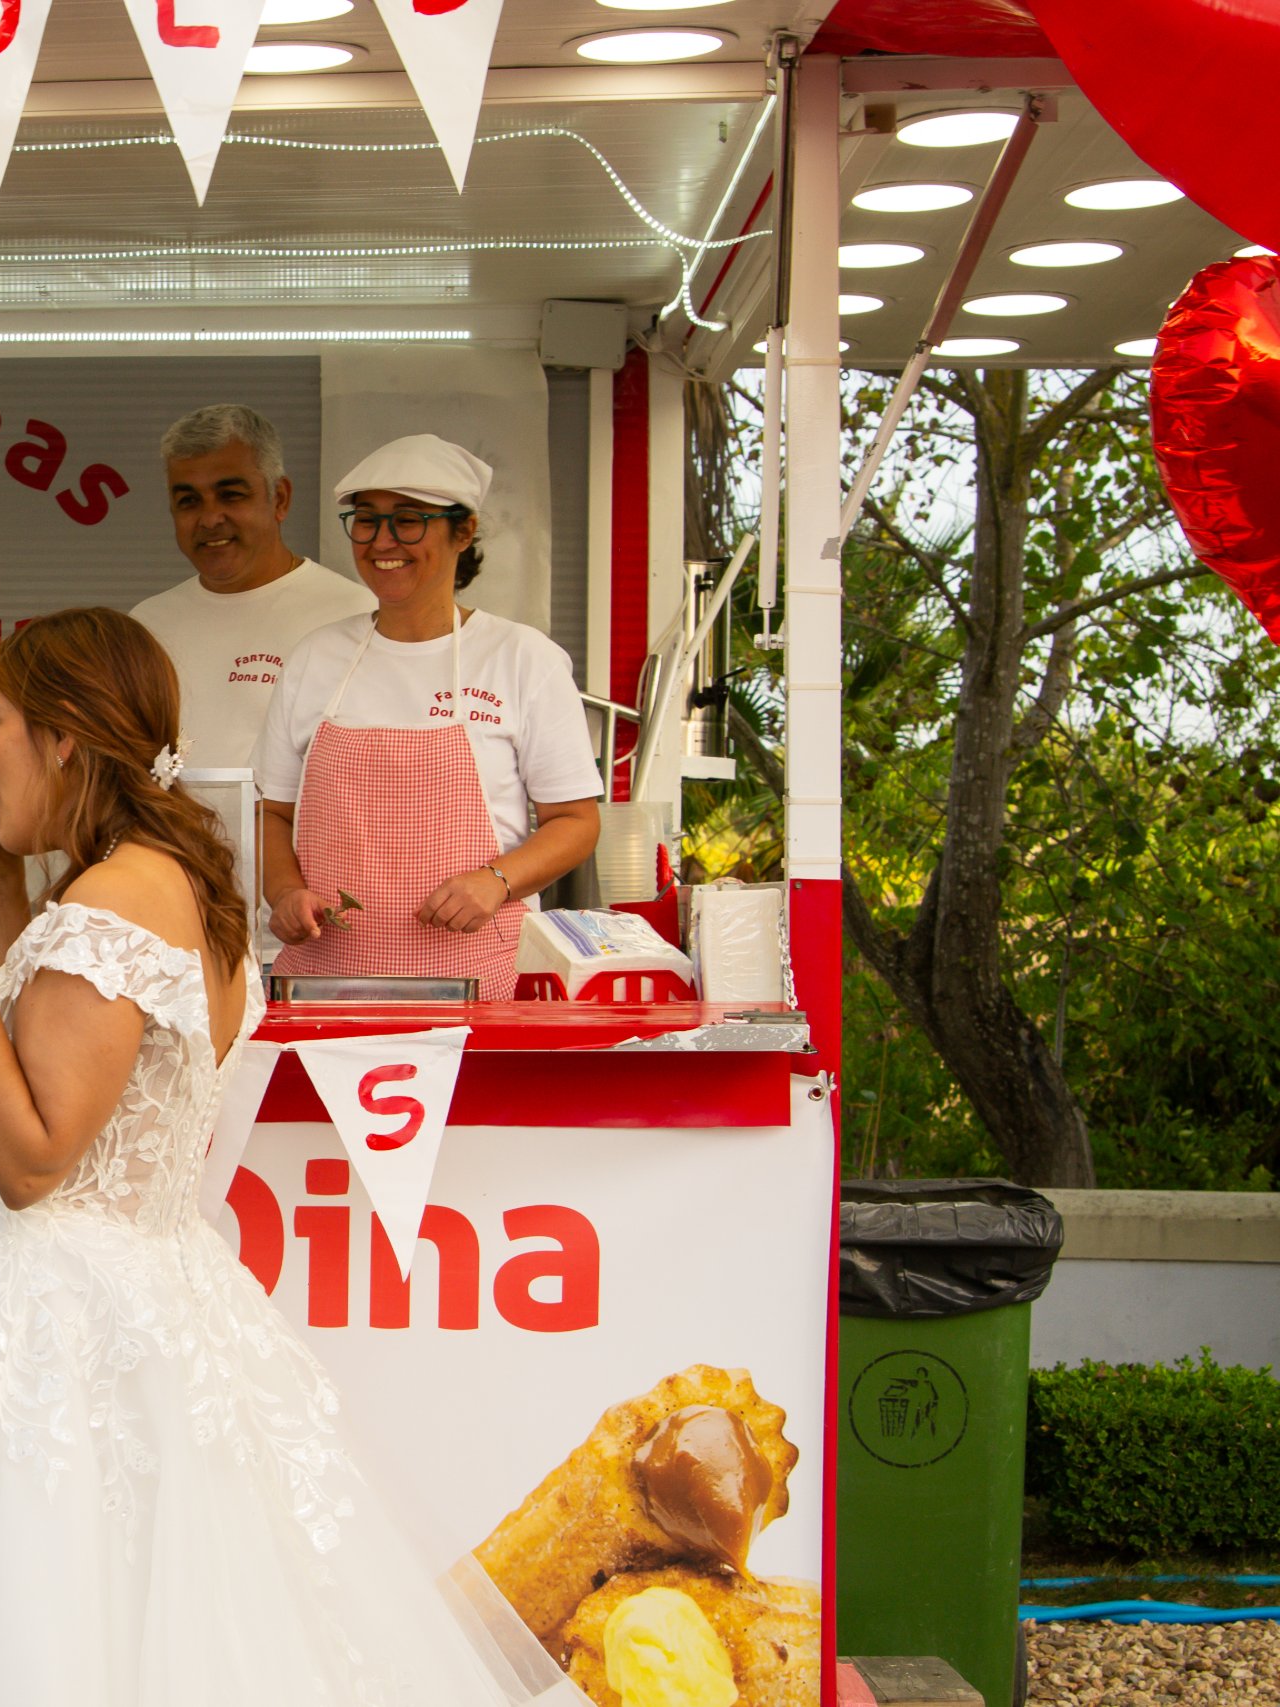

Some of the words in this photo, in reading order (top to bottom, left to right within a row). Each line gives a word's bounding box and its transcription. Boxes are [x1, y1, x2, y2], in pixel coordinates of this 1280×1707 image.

[234, 654, 284, 668] FaRTUR
[228, 672, 258, 682] Dona
[260, 672, 278, 684] Di
[434, 687, 503, 708] FaTURas
[470, 710, 502, 724] Dina
